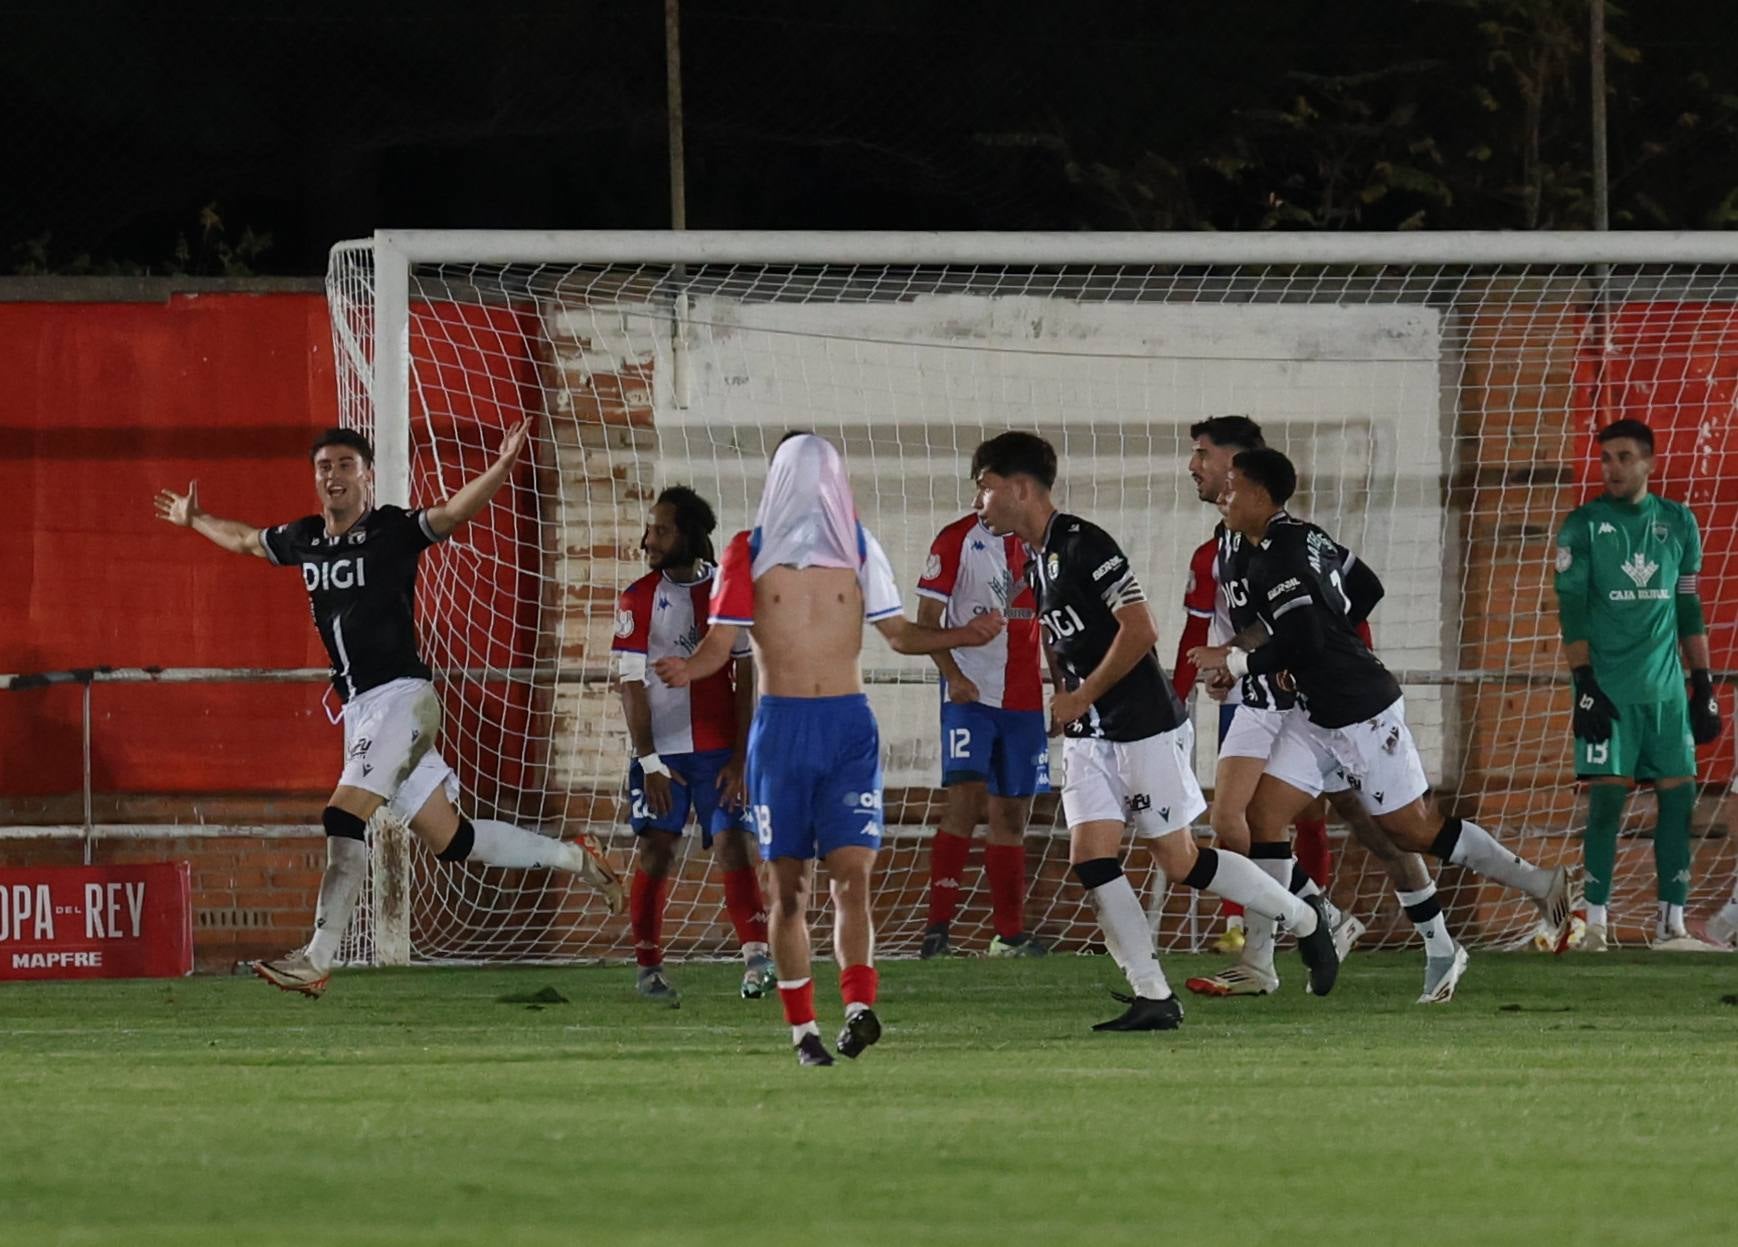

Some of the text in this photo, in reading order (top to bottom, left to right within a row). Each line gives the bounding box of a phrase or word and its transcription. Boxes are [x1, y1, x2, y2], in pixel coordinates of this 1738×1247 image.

[303, 557, 366, 592] DIGI
[950, 728, 971, 759] 12
[56, 906, 82, 914] DEL
[85, 882, 145, 938] REY
[13, 952, 102, 968] MAPFRE
